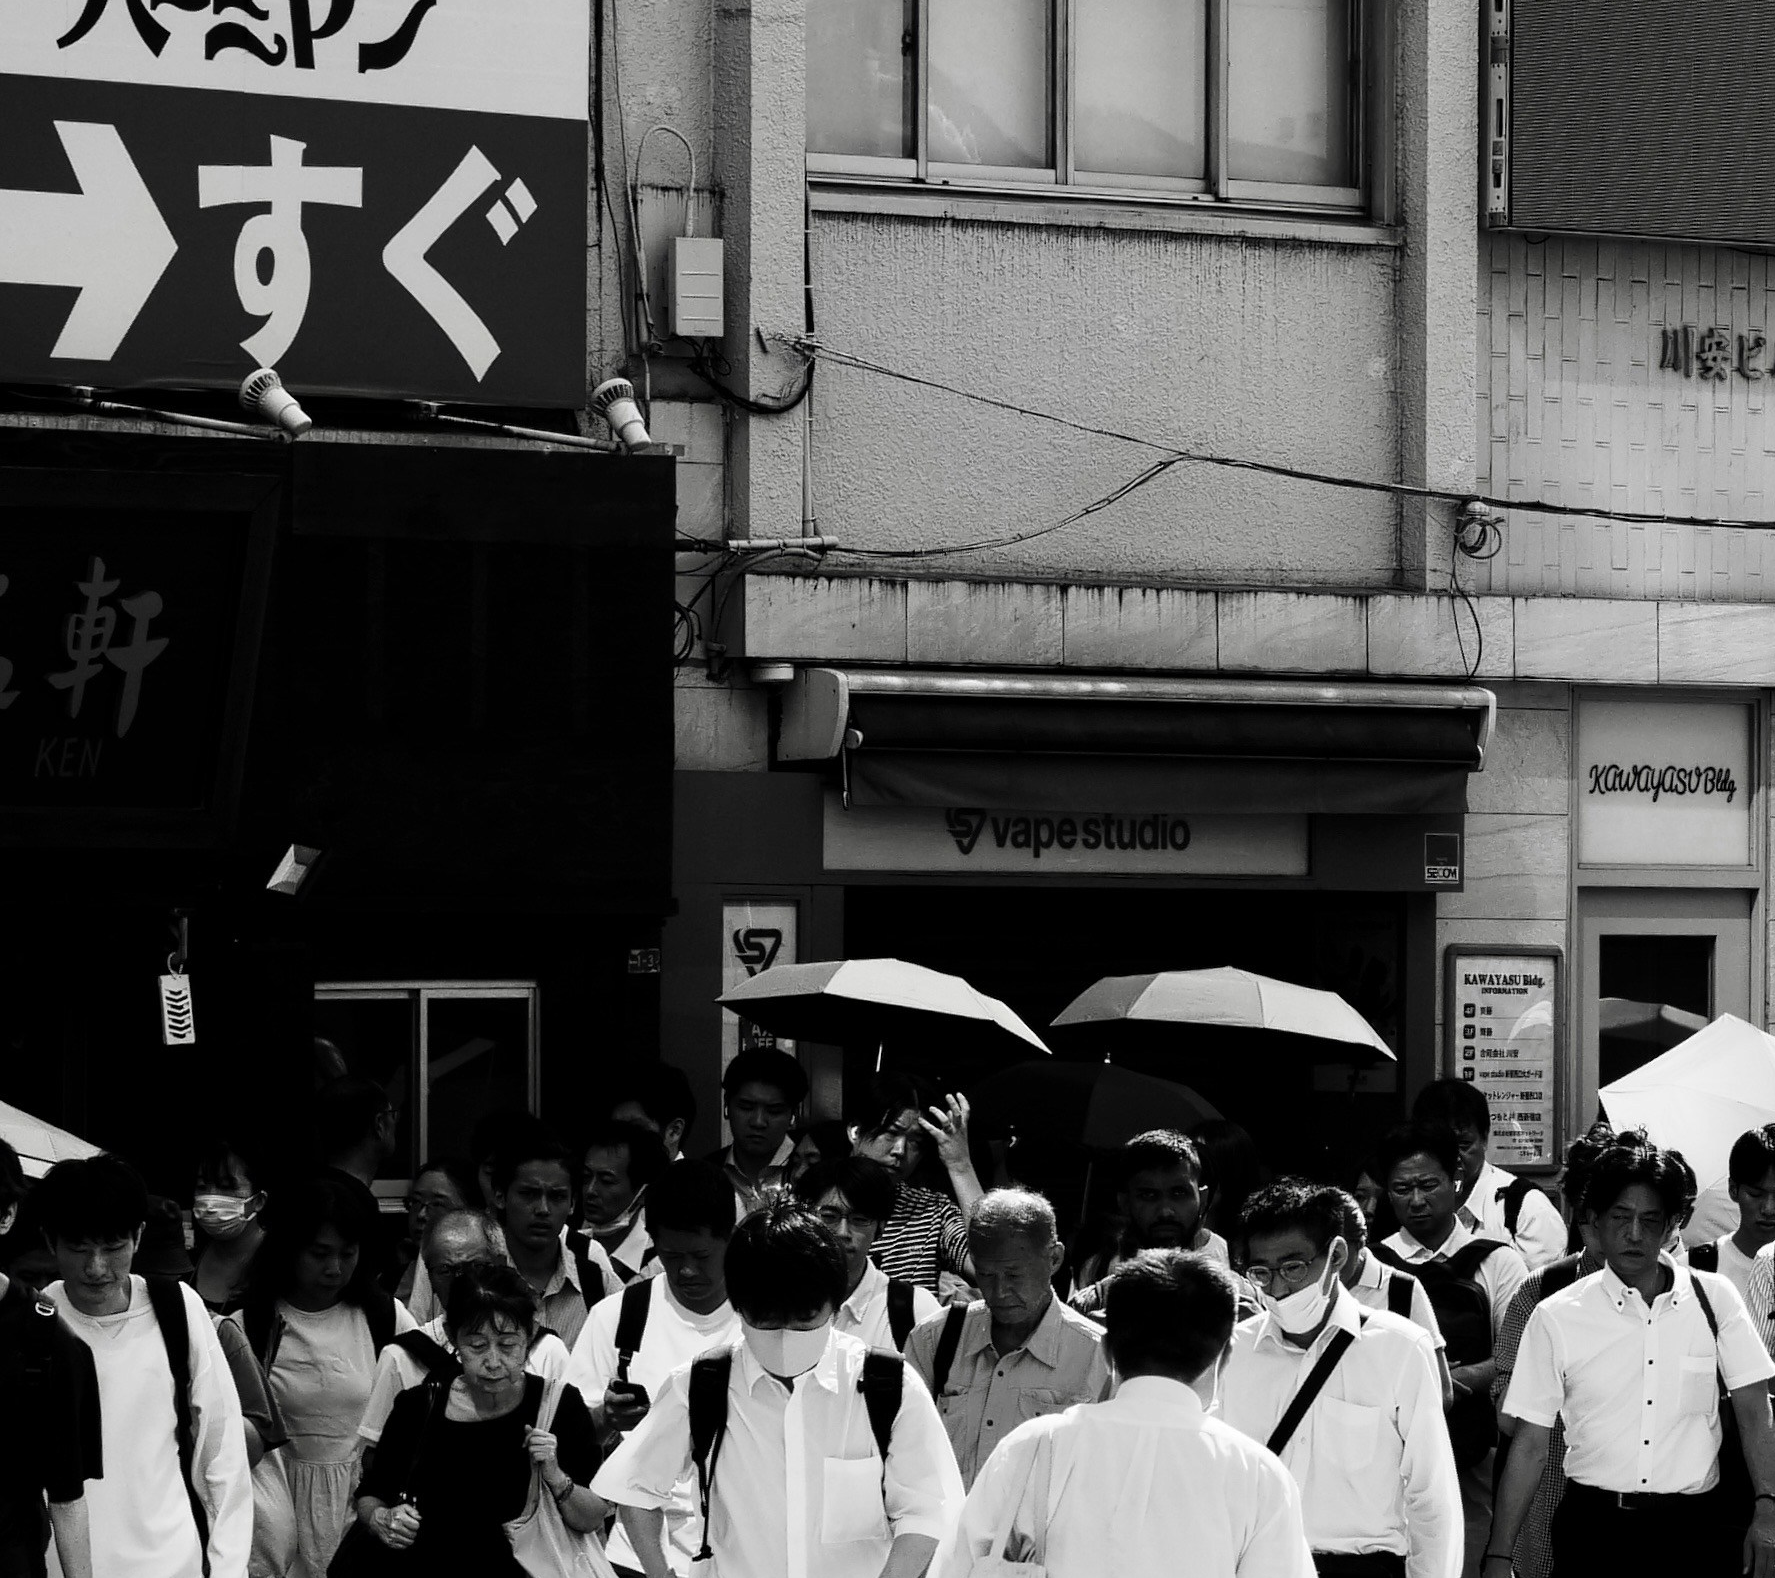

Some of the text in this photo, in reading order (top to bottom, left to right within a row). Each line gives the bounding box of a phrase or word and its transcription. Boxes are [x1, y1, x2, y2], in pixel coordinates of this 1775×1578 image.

[198, 133, 538, 383] すぐ
[34, 737, 102, 778] KEN
[1464, 974, 1545, 989] KAWAYASU Bldg.
[1481, 987, 1528, 995] INFORMATION
